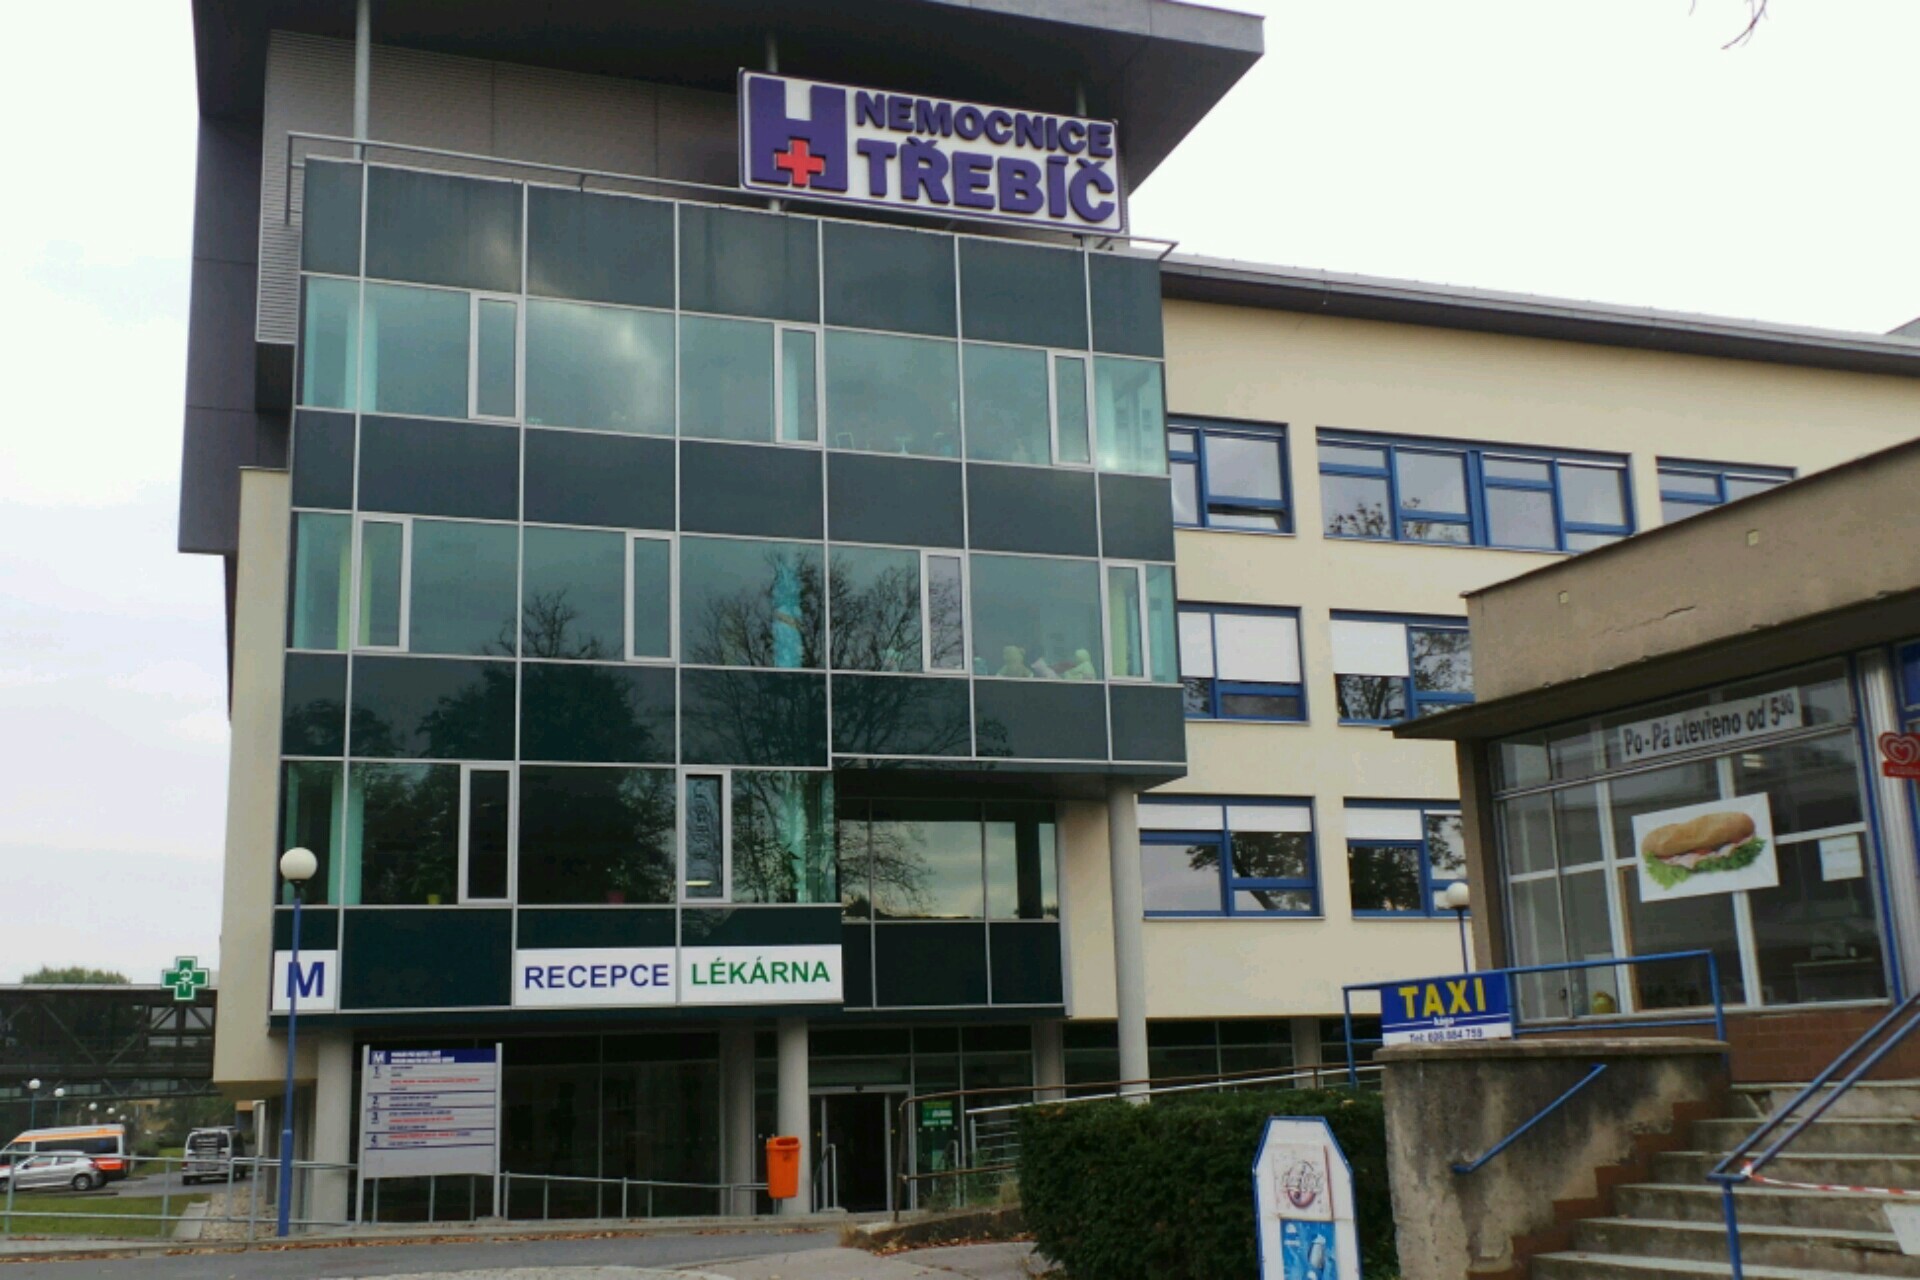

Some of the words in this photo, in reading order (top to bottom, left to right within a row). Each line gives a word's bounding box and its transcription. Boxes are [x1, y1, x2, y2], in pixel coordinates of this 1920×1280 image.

[855, 90, 1114, 158] NEMOCNICE
[856, 136, 1116, 222] TŘEBÍČ
[1746, 699, 1766, 731] od
[287, 961, 325, 998] M
[525, 963, 670, 990] RECEPCE
[691, 956, 831, 985] LÉKÁRNA
[1398, 977, 1487, 1019] TAXI
